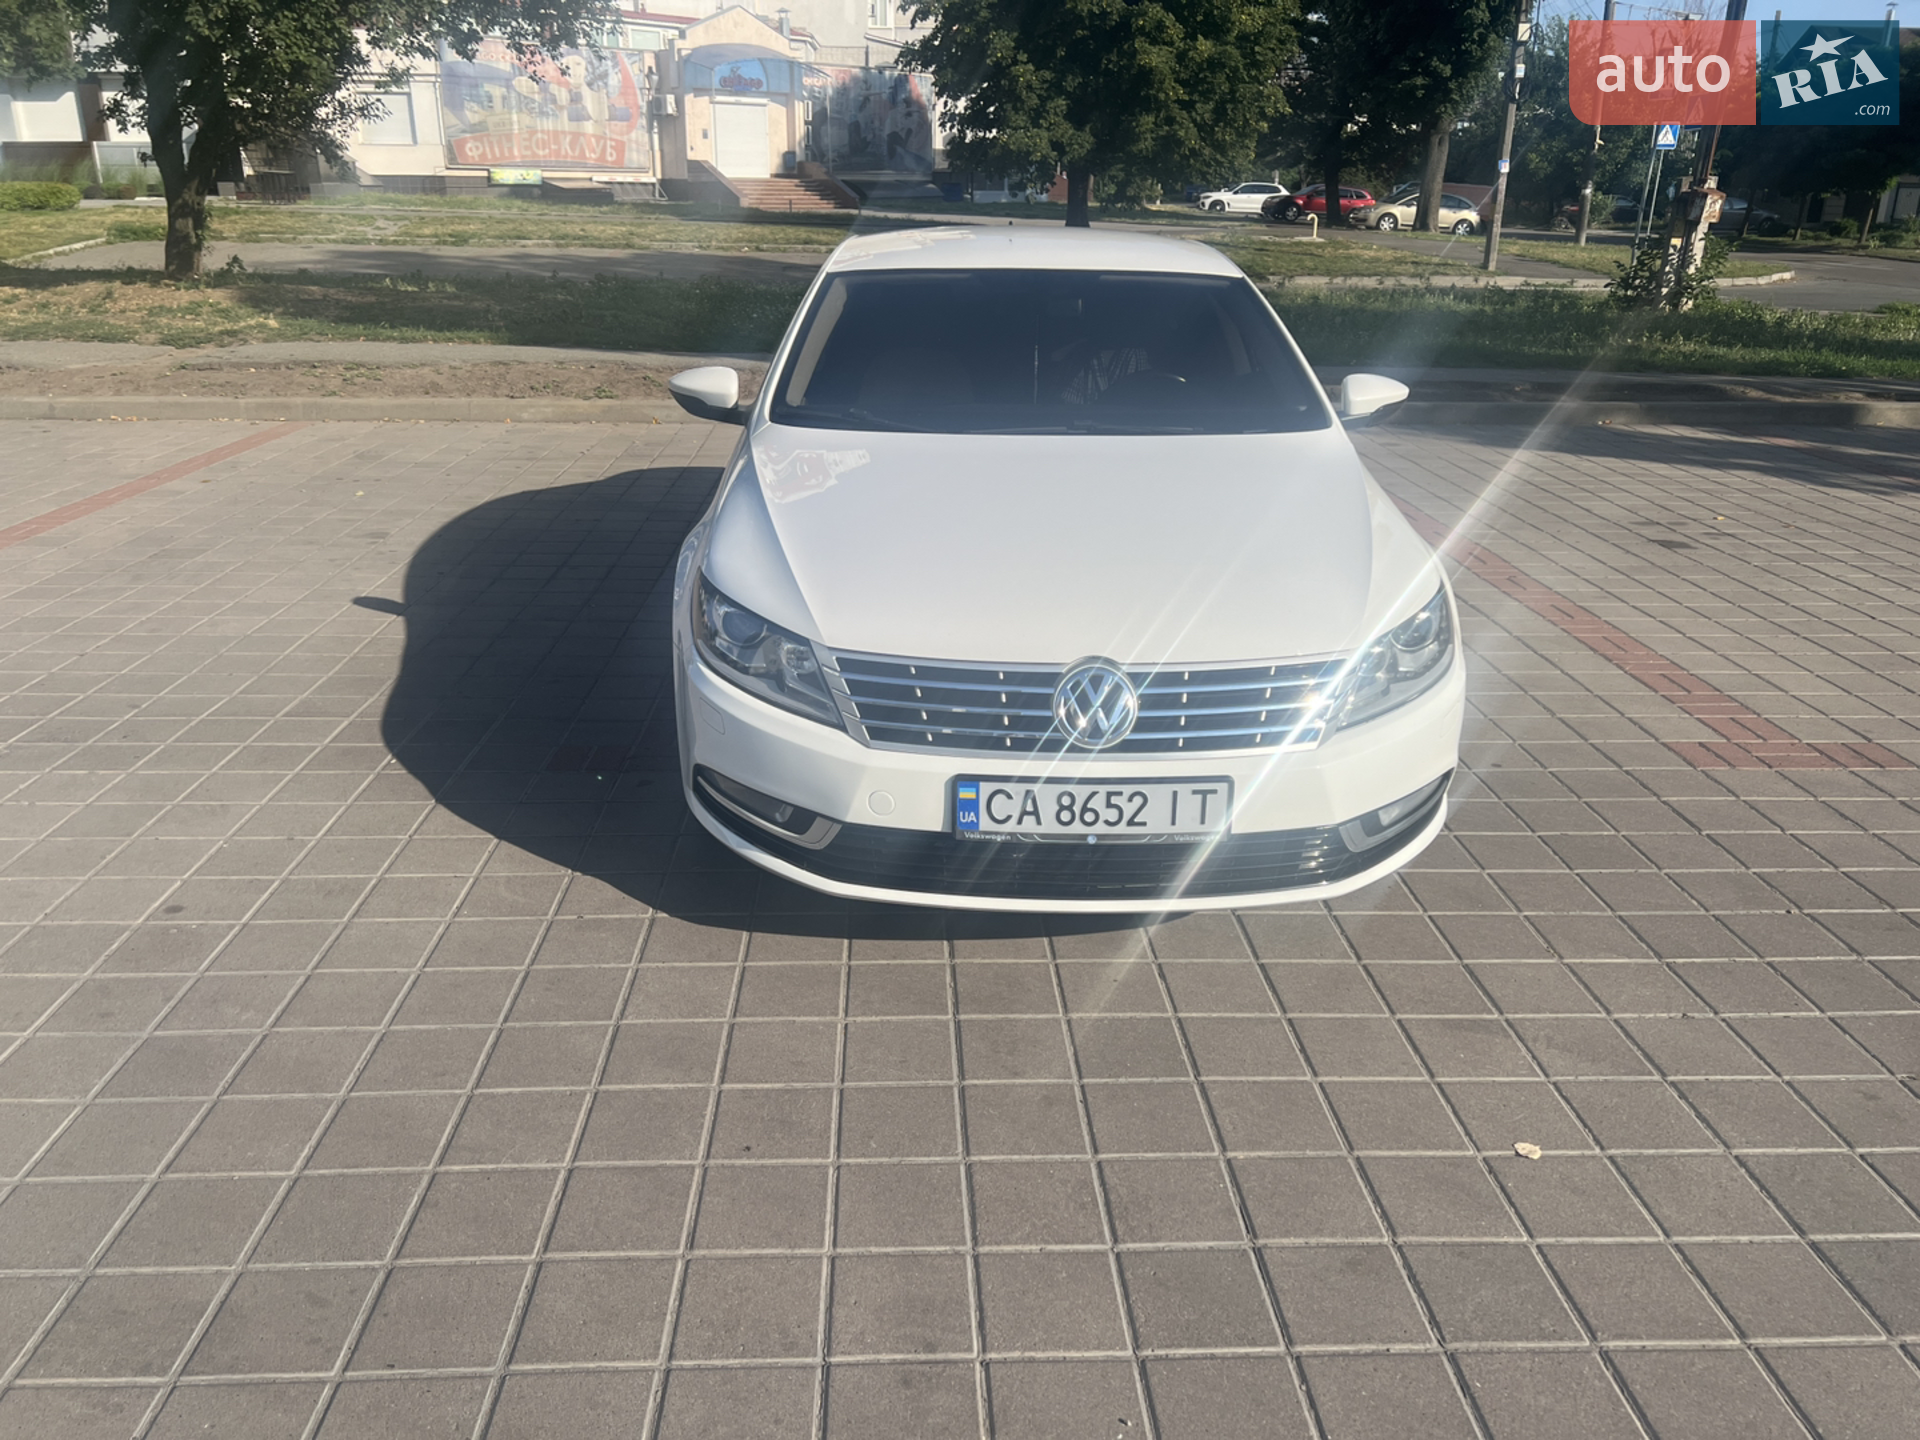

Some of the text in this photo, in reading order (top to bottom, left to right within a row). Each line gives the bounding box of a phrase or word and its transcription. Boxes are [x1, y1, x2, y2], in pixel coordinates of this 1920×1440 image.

[959, 788, 1218, 827] UA CA 8652 IT
[964, 831, 1012, 841] Volkswagen
